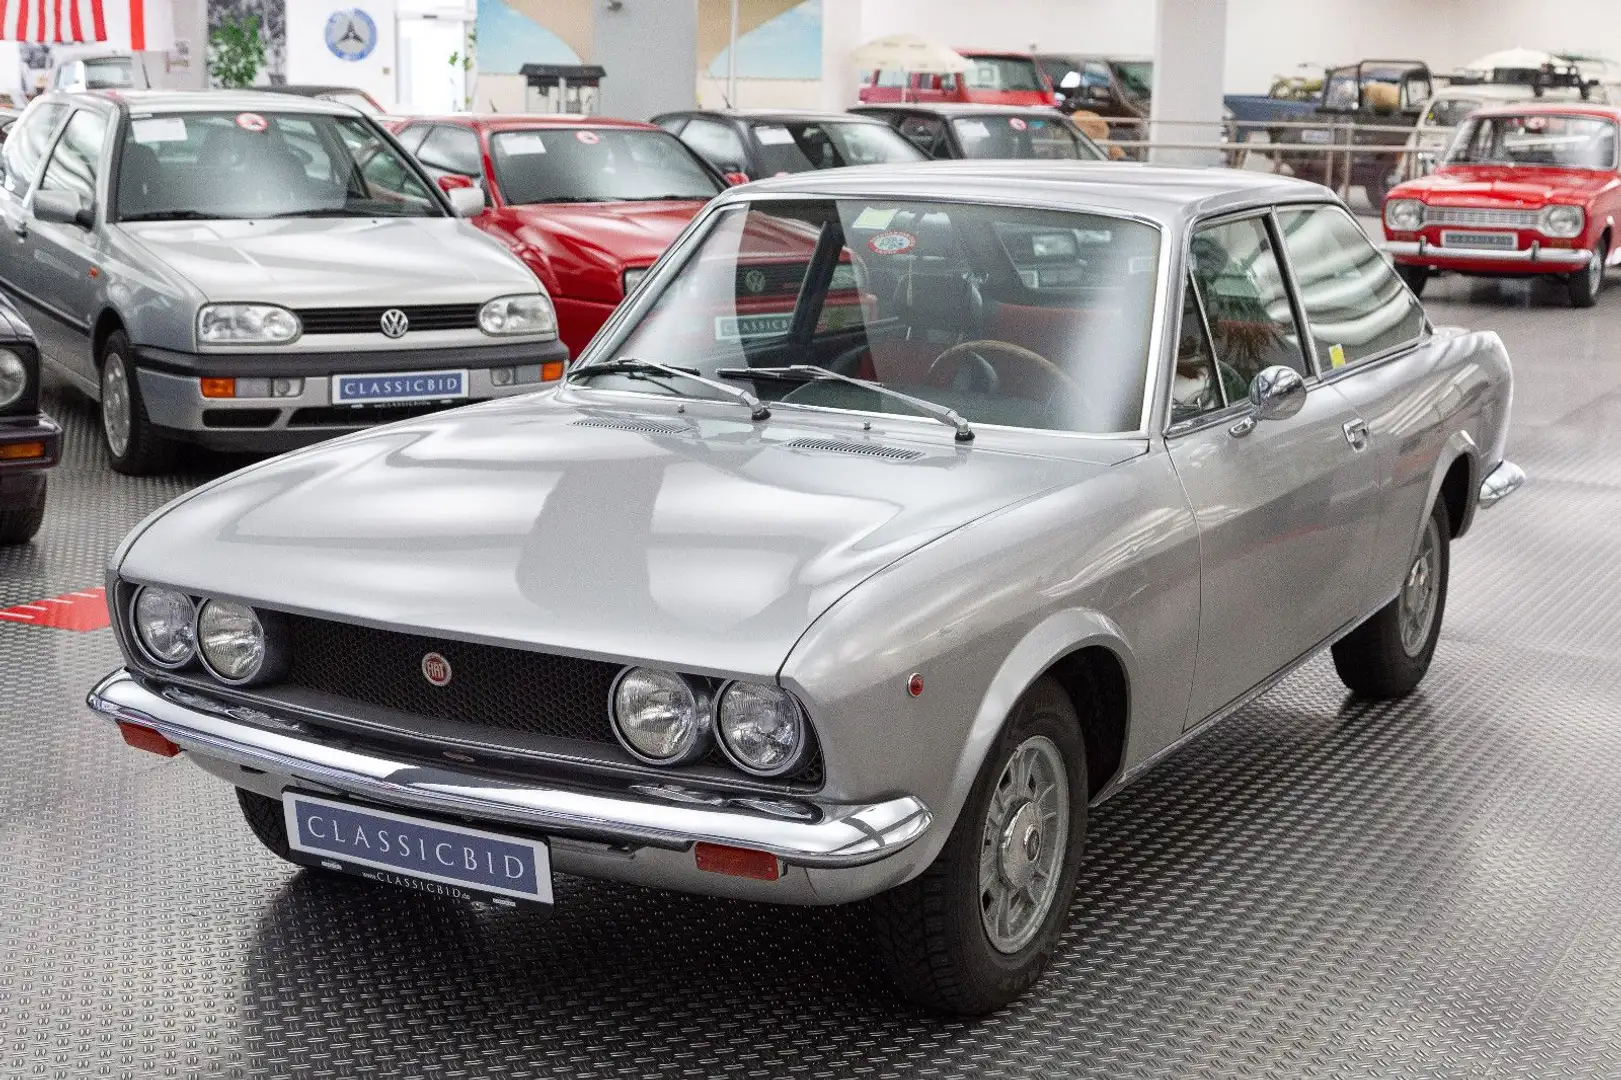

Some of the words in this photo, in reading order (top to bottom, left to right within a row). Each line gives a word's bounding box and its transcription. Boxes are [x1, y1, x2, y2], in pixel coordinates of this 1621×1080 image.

[381, 309, 409, 338] VW
[344, 377, 458, 395] CLASSICBID
[426, 660, 444, 678] FIAT
[307, 815, 525, 879] CLASSICBID
